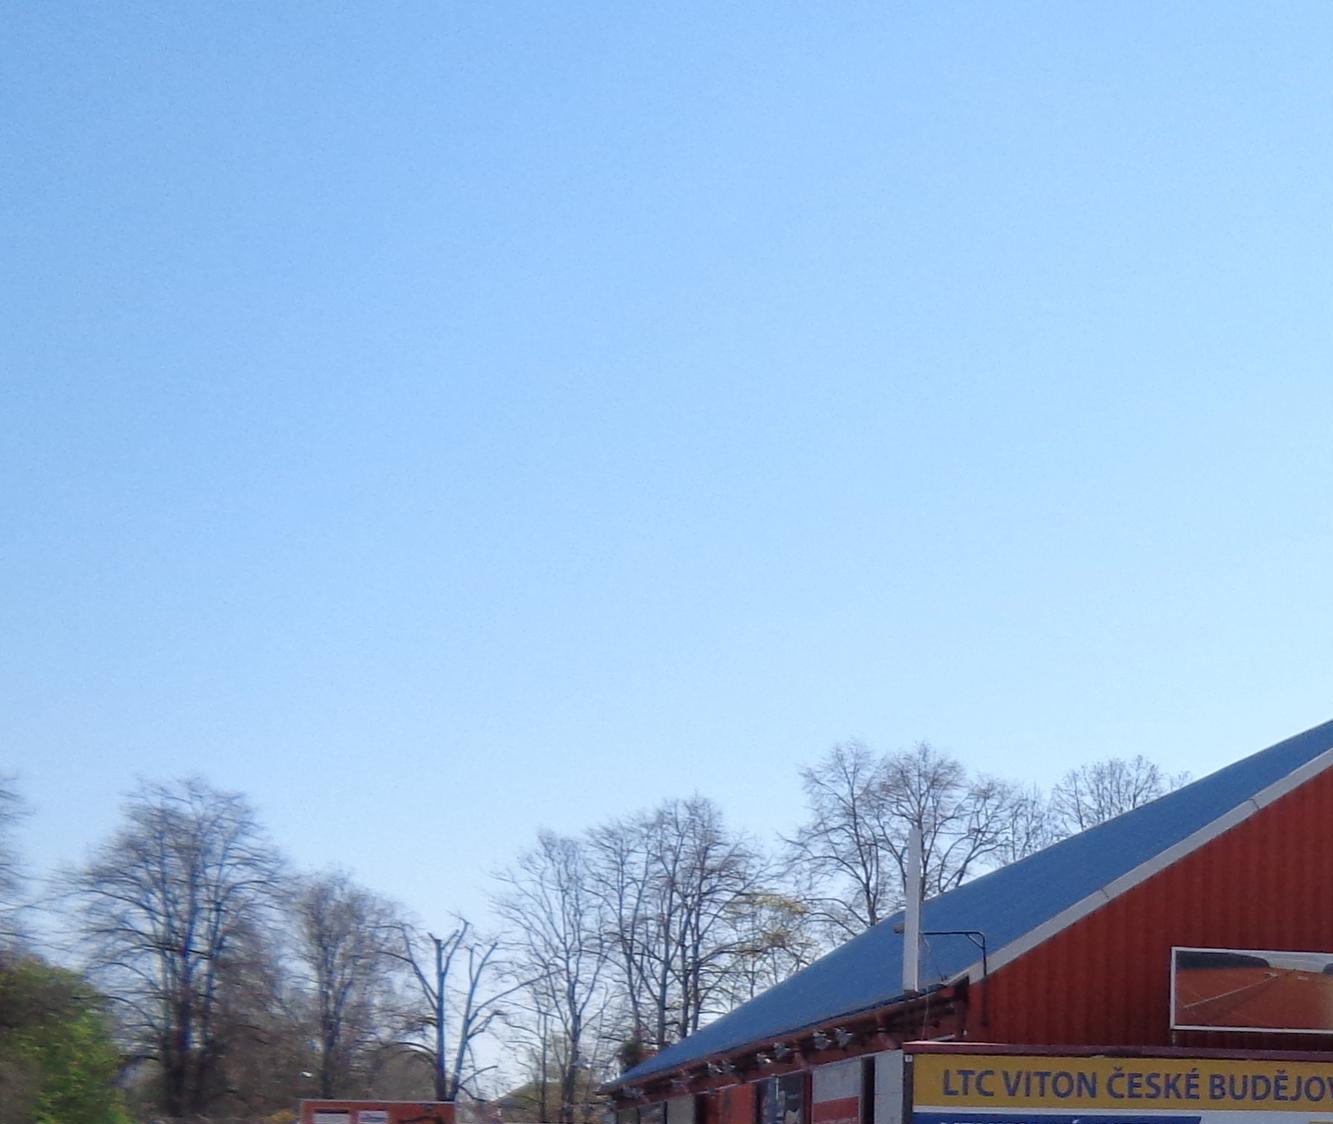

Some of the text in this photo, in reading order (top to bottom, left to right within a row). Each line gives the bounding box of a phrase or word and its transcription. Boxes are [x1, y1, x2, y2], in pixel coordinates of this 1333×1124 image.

[943, 1068, 1000, 1098] LTC
[1002, 1070, 1098, 1099] VITON
[1106, 1066, 1200, 1100] ČESKÉ
